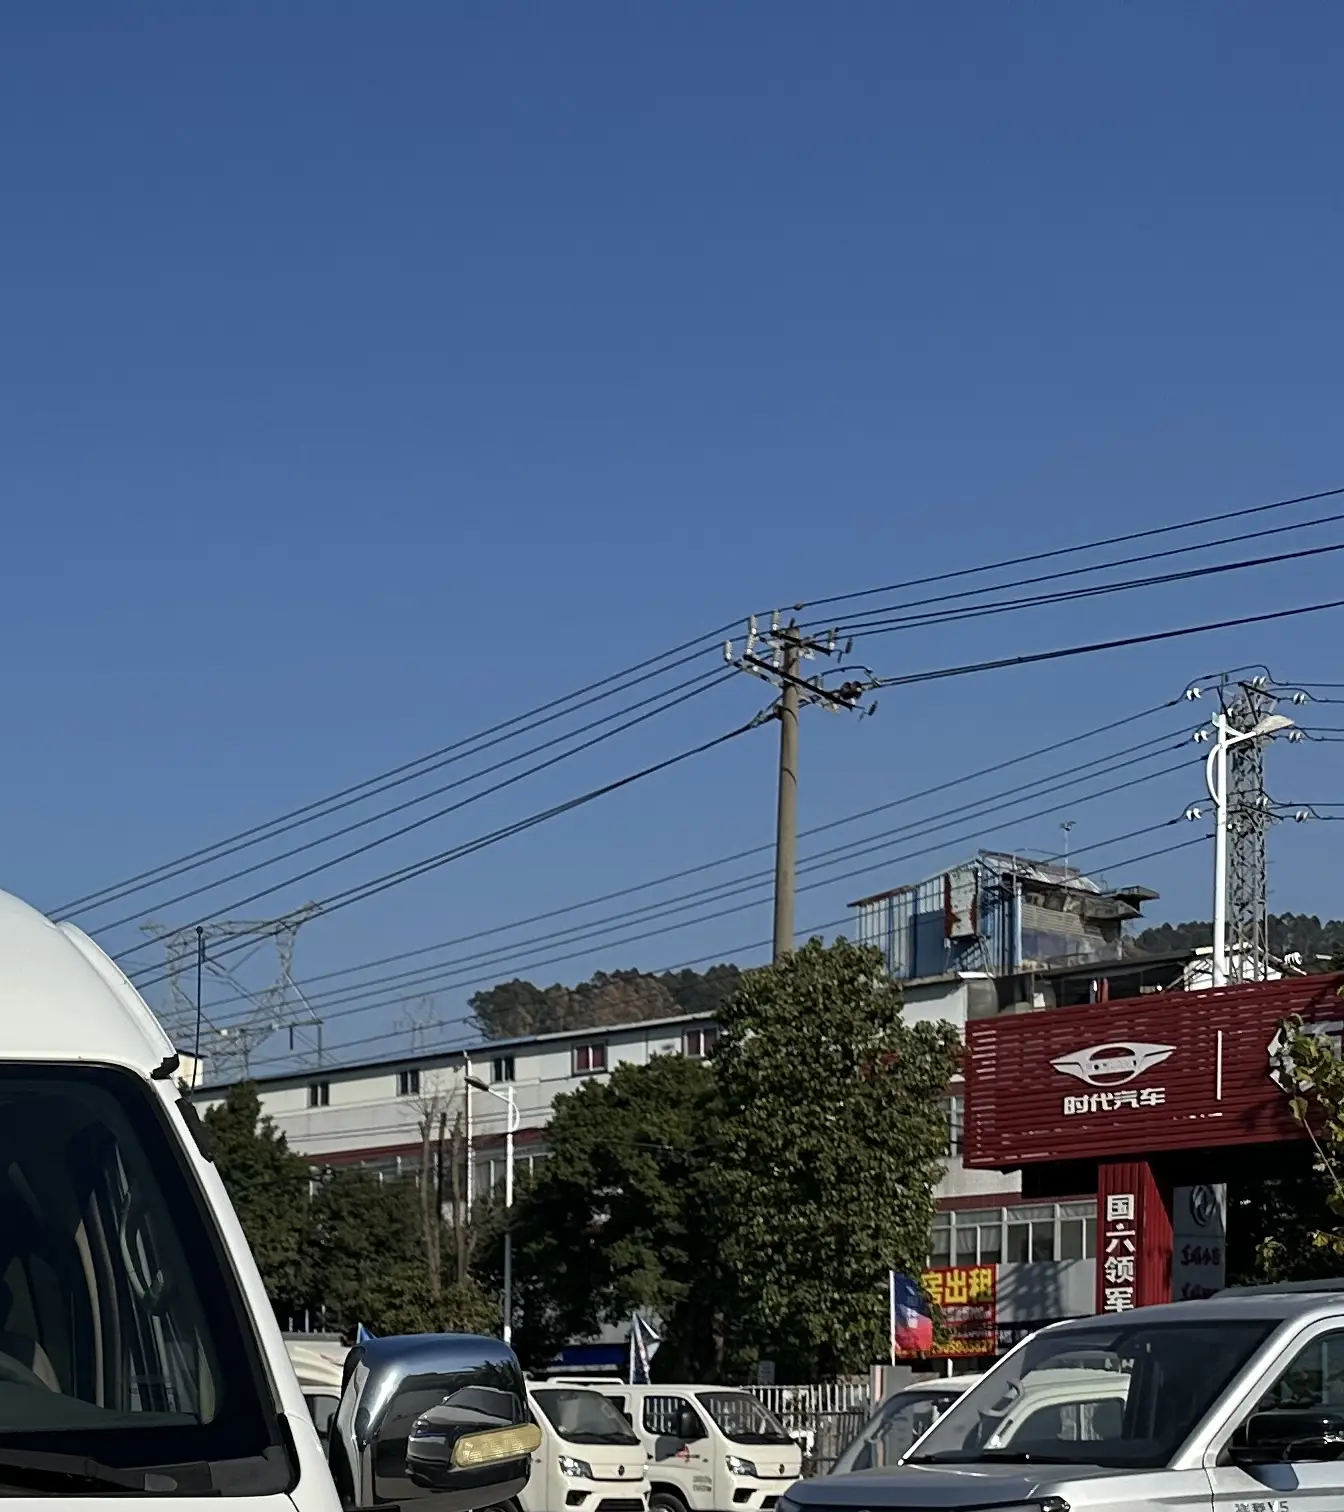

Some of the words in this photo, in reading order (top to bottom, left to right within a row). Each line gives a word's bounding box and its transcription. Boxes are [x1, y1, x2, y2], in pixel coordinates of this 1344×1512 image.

[1063, 1087, 1166, 1115] 时代汽车
[1104, 1193, 1136, 1313] 国六领军
